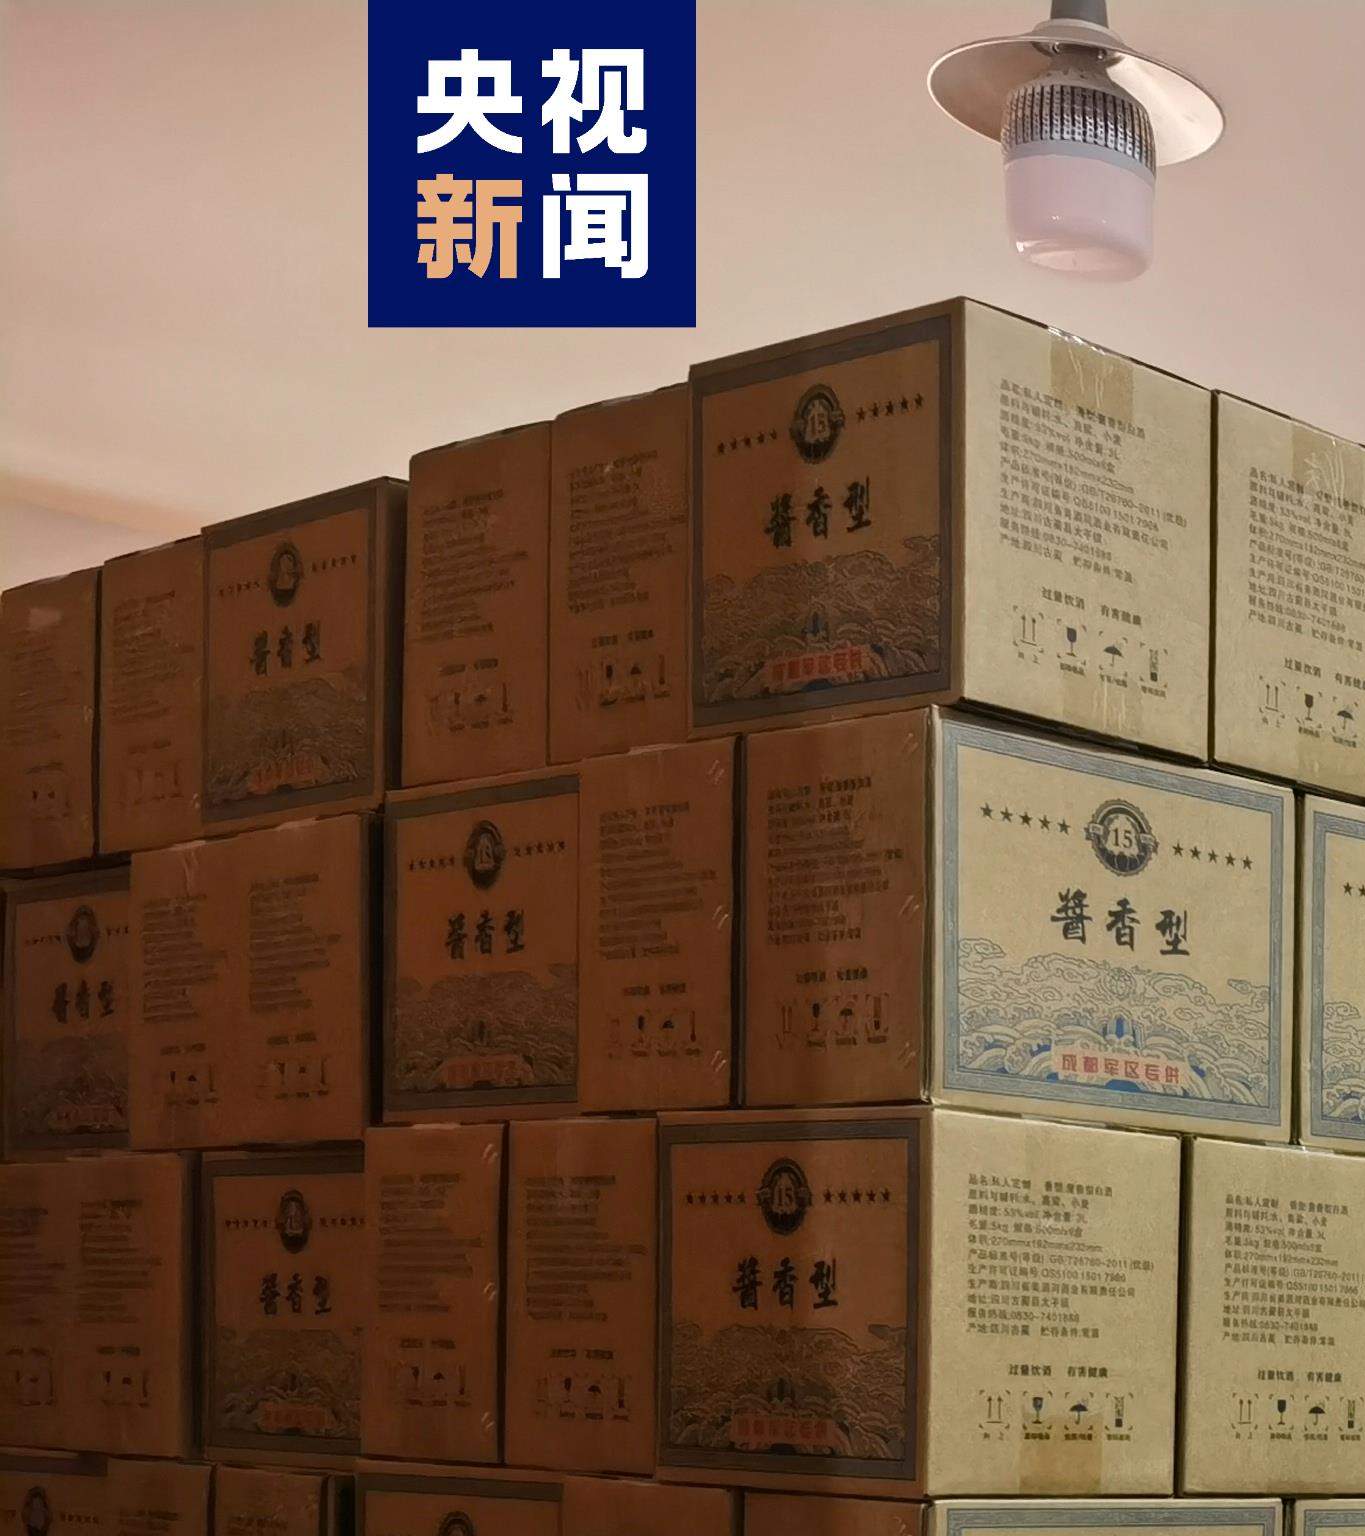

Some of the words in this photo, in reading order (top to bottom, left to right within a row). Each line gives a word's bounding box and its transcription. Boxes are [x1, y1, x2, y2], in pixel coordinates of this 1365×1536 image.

[1112, 826, 1133, 849] 15
[1050, 883, 1190, 960] 醬香型
[1061, 1054, 1180, 1084] 成都军区专供
[732, 1255, 838, 1311] 醬香型
[1009, 1364, 1051, 1376] 过量饮酒
[1067, 1365, 1107, 1377] 有害健康
[1257, 1369, 1293, 1381] 过量饮酒
[1307, 1371, 1341, 1382] 有害健康
